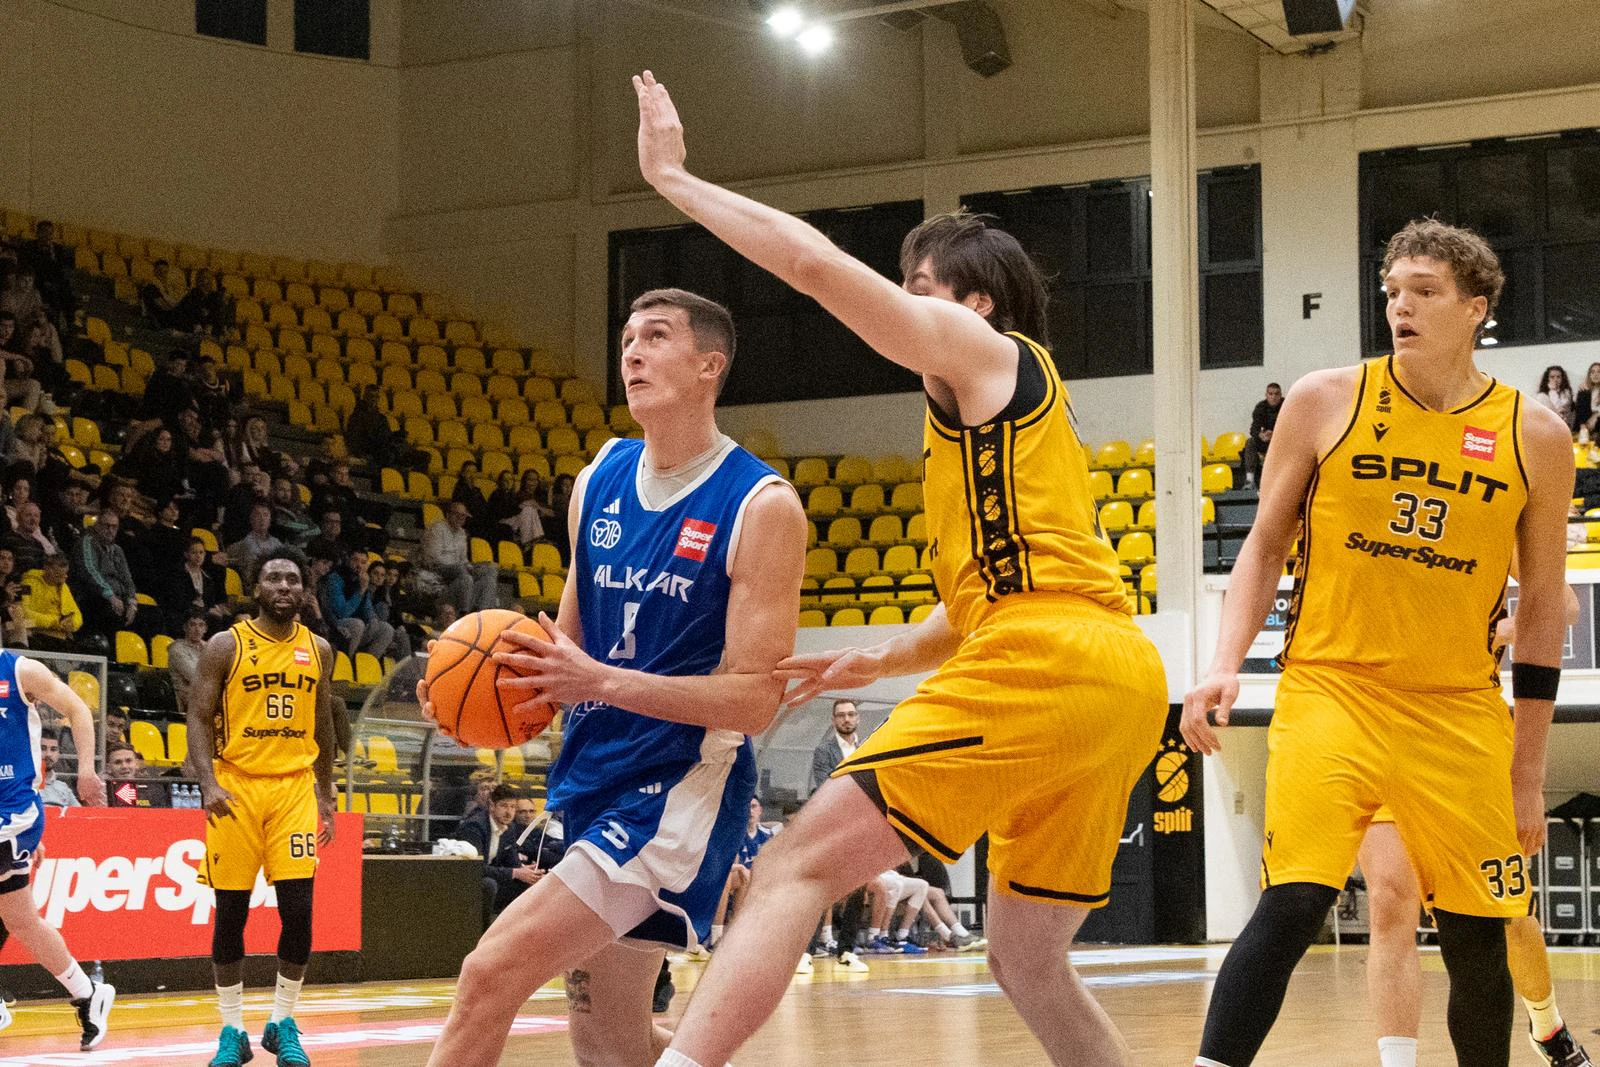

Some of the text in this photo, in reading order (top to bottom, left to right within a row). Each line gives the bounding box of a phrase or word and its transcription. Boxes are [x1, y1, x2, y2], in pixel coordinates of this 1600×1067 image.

[1303, 292, 1322, 319] F
[1463, 432, 1496, 446] Super
[1463, 441, 1494, 454] Sport
[1351, 454, 1509, 503] SPLIT
[1388, 490, 1449, 542] 33
[678, 537, 709, 552] Sport
[680, 527, 714, 541] Super
[1345, 532, 1477, 575] SuperSport
[594, 564, 694, 603] ALKAR
[242, 672, 317, 693] SPLIT
[266, 692, 295, 720] 66
[1153, 806, 1194, 834] split
[289, 831, 317, 859] 66
[1479, 853, 1528, 901] 33
